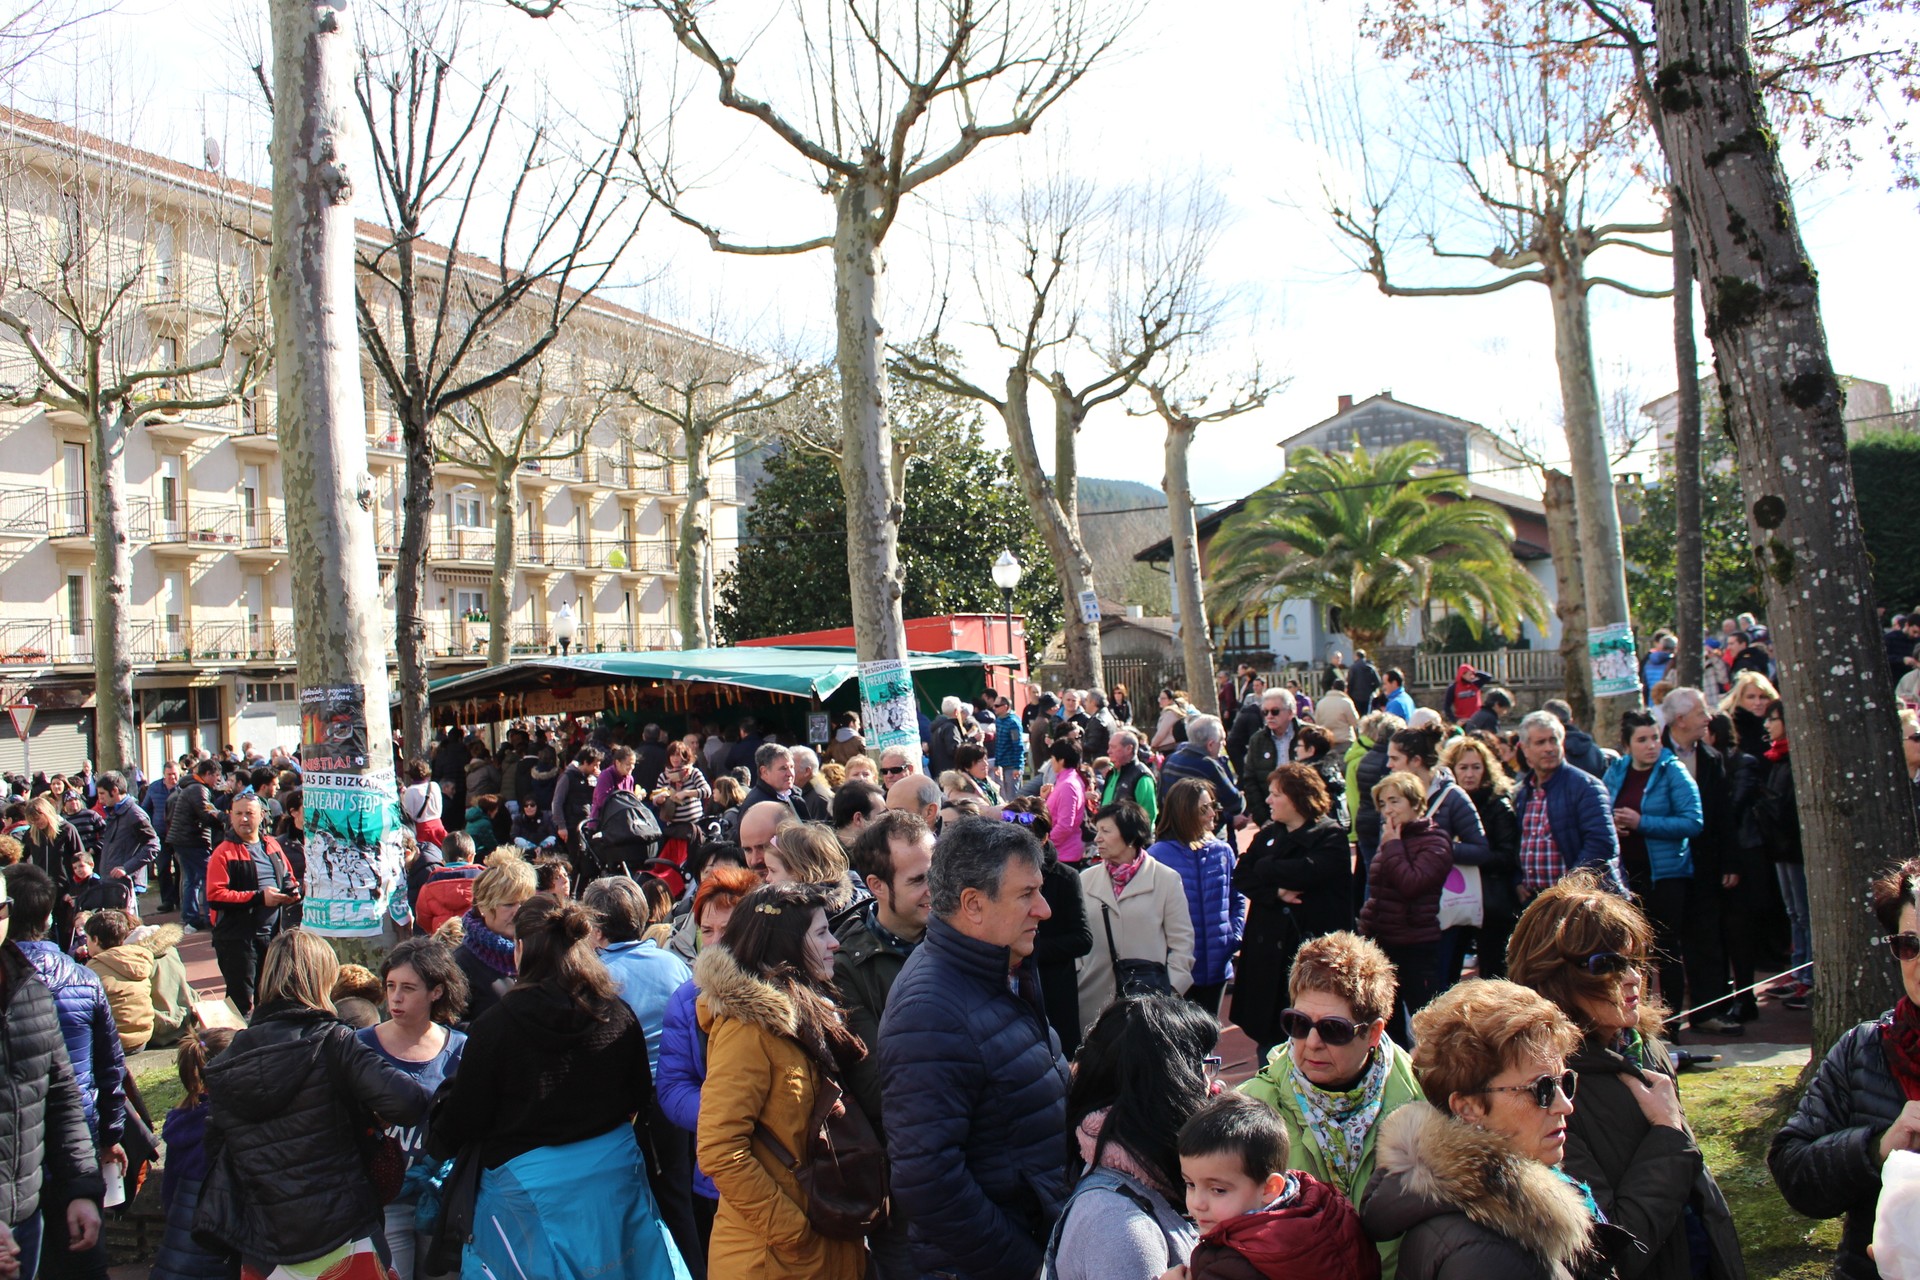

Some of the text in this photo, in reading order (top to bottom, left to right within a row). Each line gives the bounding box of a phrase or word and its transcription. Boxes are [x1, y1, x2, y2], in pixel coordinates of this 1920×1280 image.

[318, 775, 331, 786] DE
[349, 793, 380, 815] STOP
[329, 901, 376, 922] ELA
